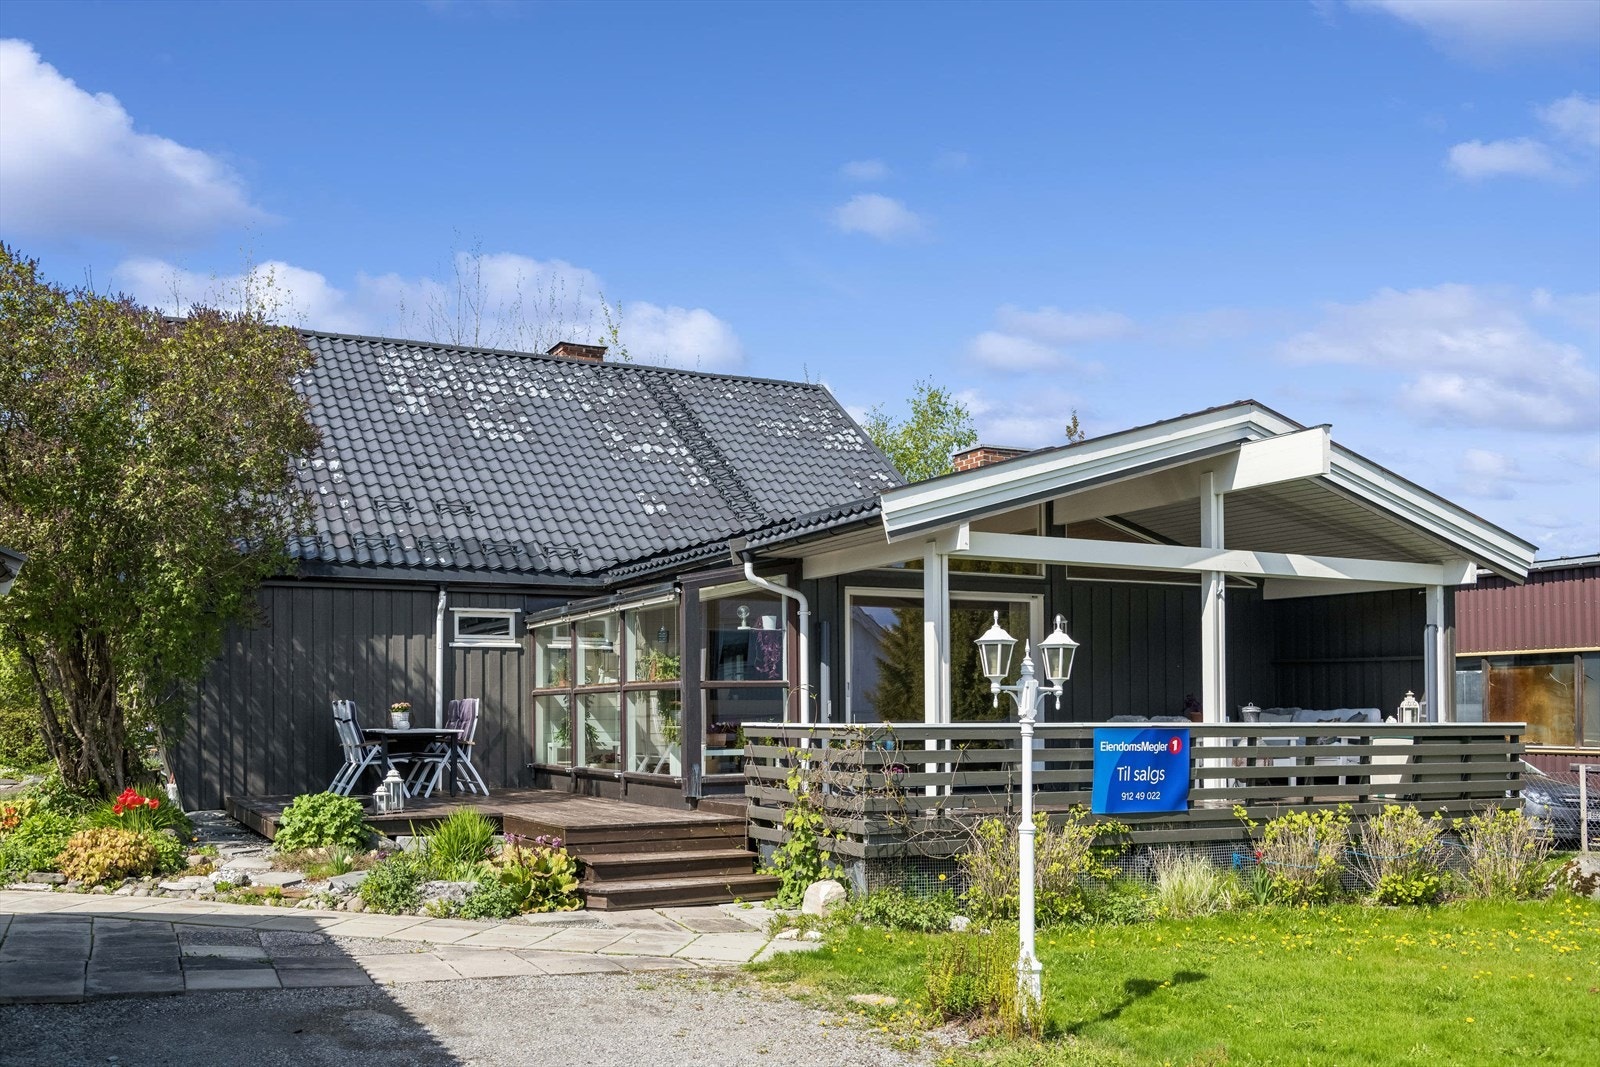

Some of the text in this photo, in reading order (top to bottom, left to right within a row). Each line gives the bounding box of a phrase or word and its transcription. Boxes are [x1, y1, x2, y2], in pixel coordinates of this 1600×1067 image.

[1100, 741, 1168, 754] EiendomsMegler
[1117, 766, 1165, 784] Til salgs
[1121, 791, 1160, 800] 912 49 022
